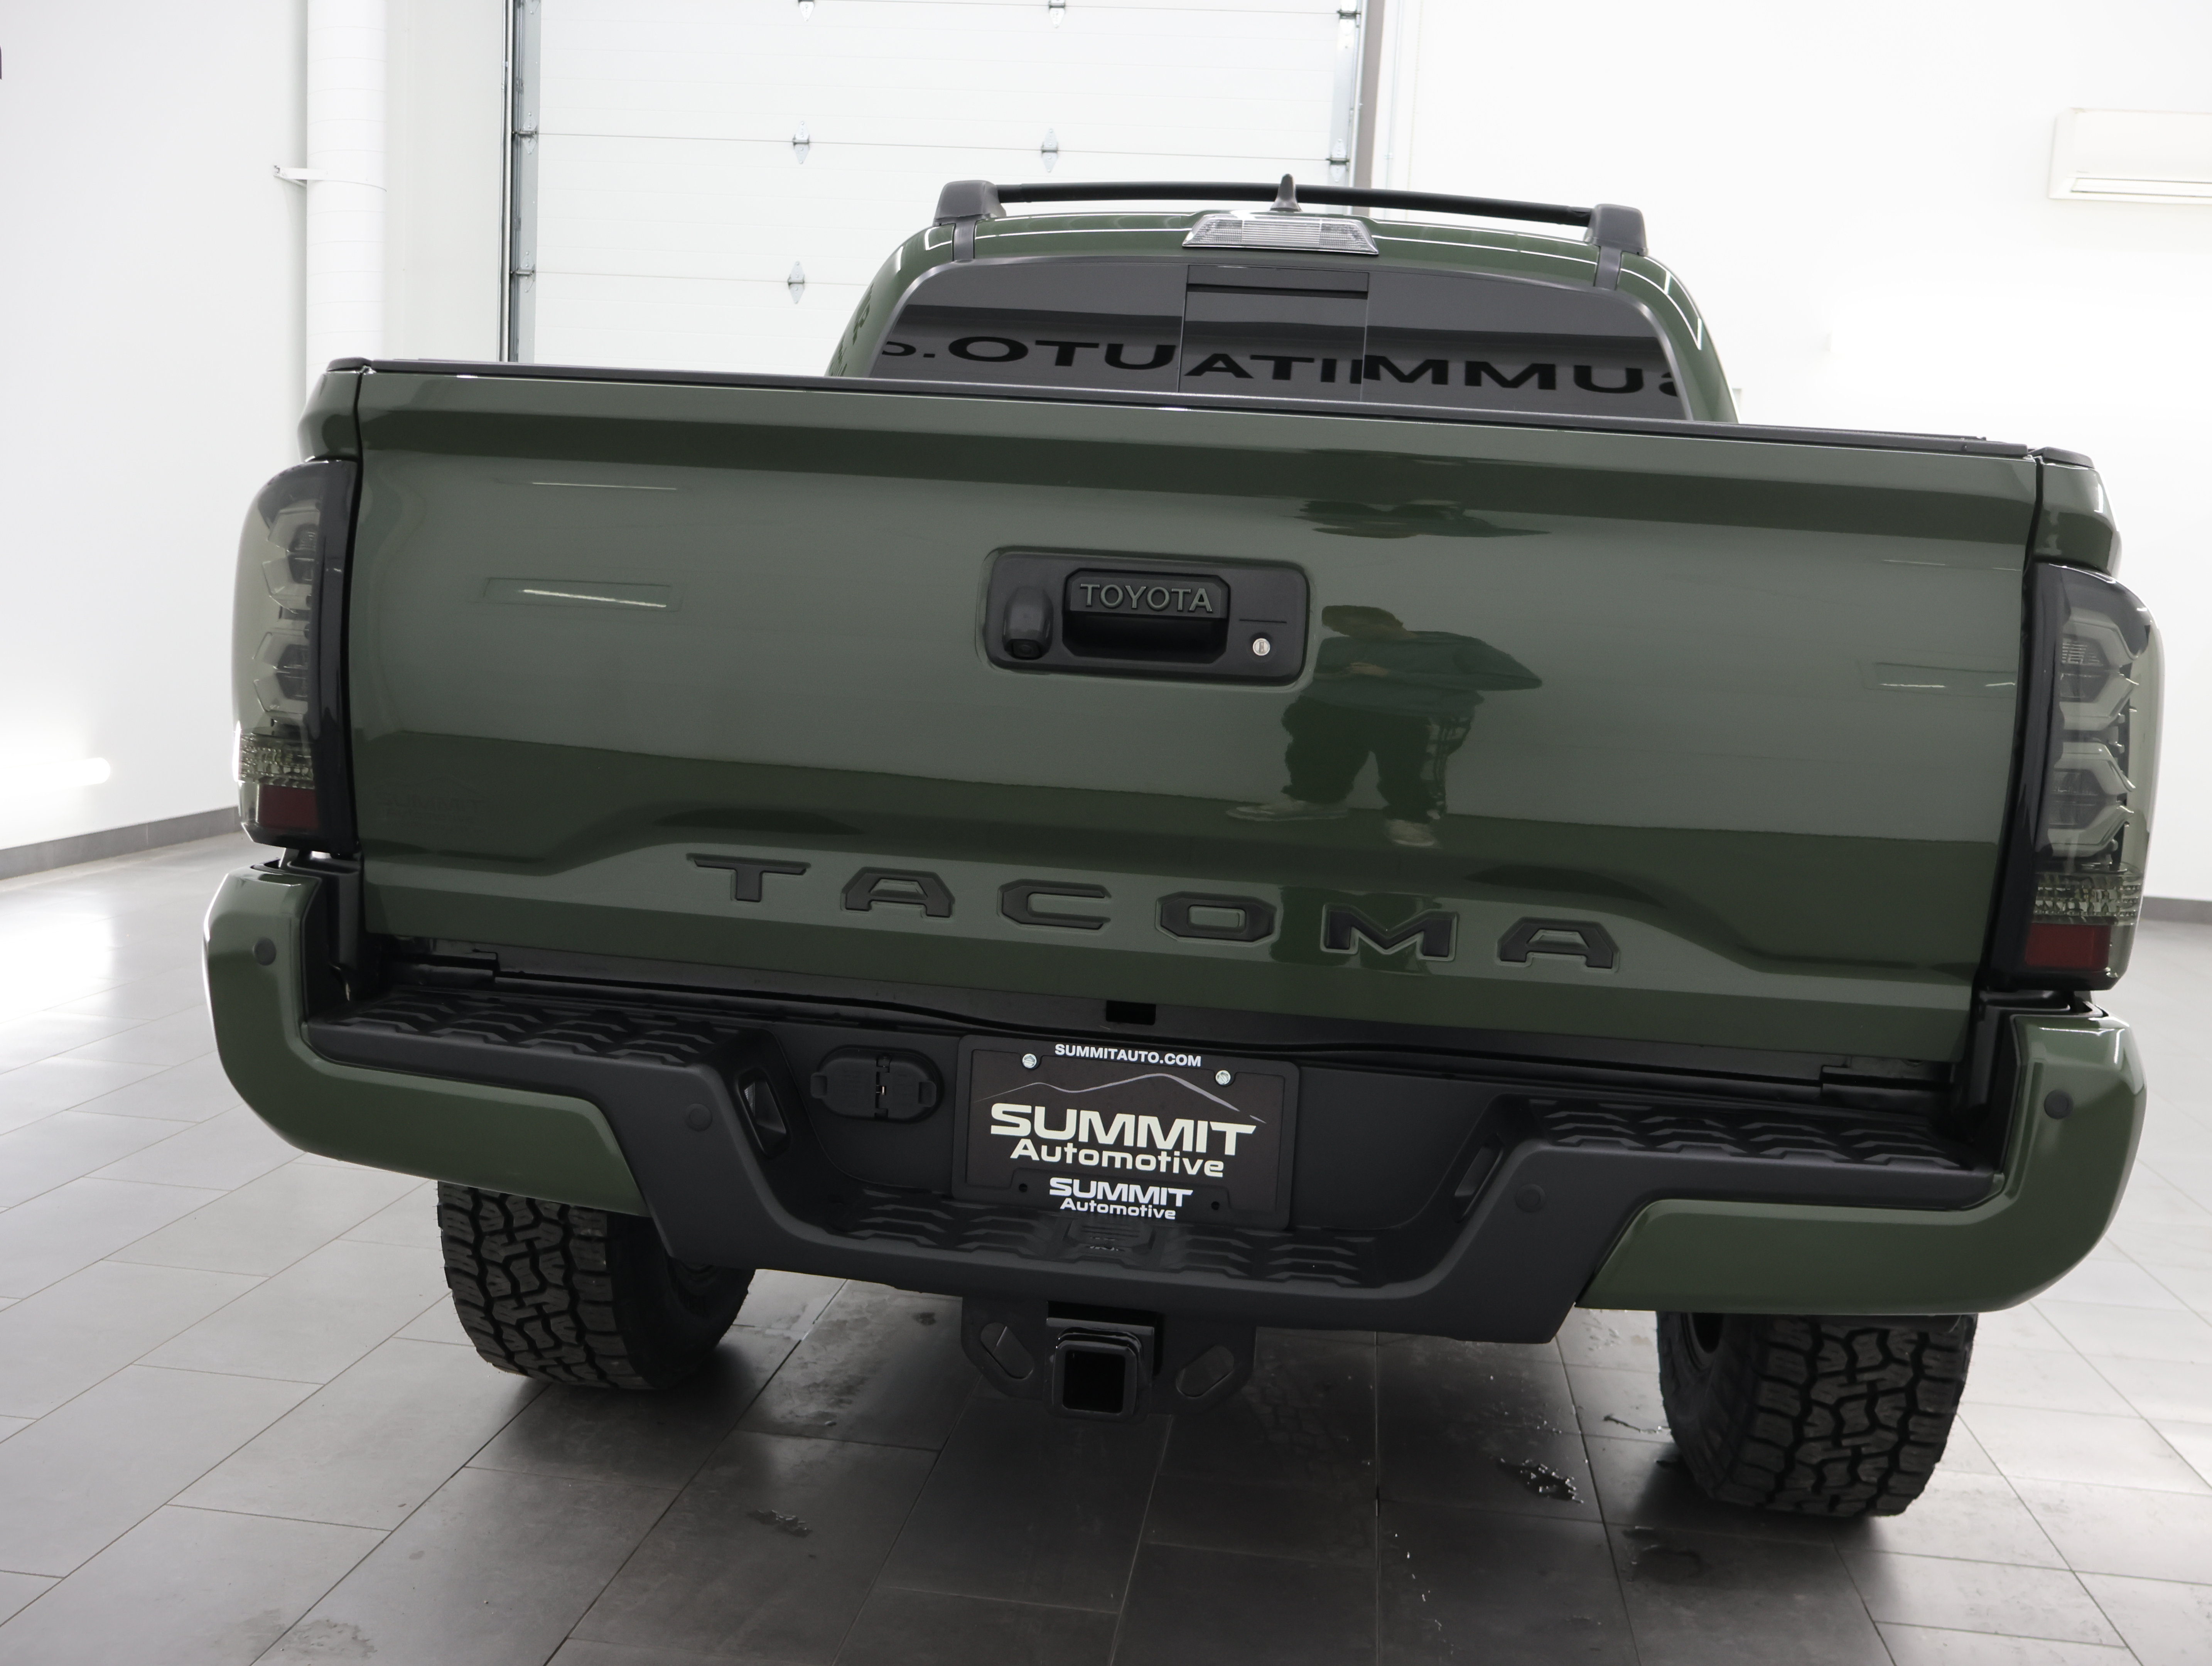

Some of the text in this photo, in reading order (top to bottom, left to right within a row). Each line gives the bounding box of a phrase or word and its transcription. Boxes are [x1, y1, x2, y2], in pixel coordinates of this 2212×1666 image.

[1080, 583, 1213, 614] TOYOTA
[687, 853, 1618, 969] TACOMA
[1055, 1044, 1201, 1067] SUMMITAUTO.COM
[990, 1103, 1257, 1156] SUMMIT
[1010, 1138, 1224, 1178] Automotive
[1049, 1177, 1194, 1207] SUMMIT
[1060, 1198, 1176, 1220] Automotive
